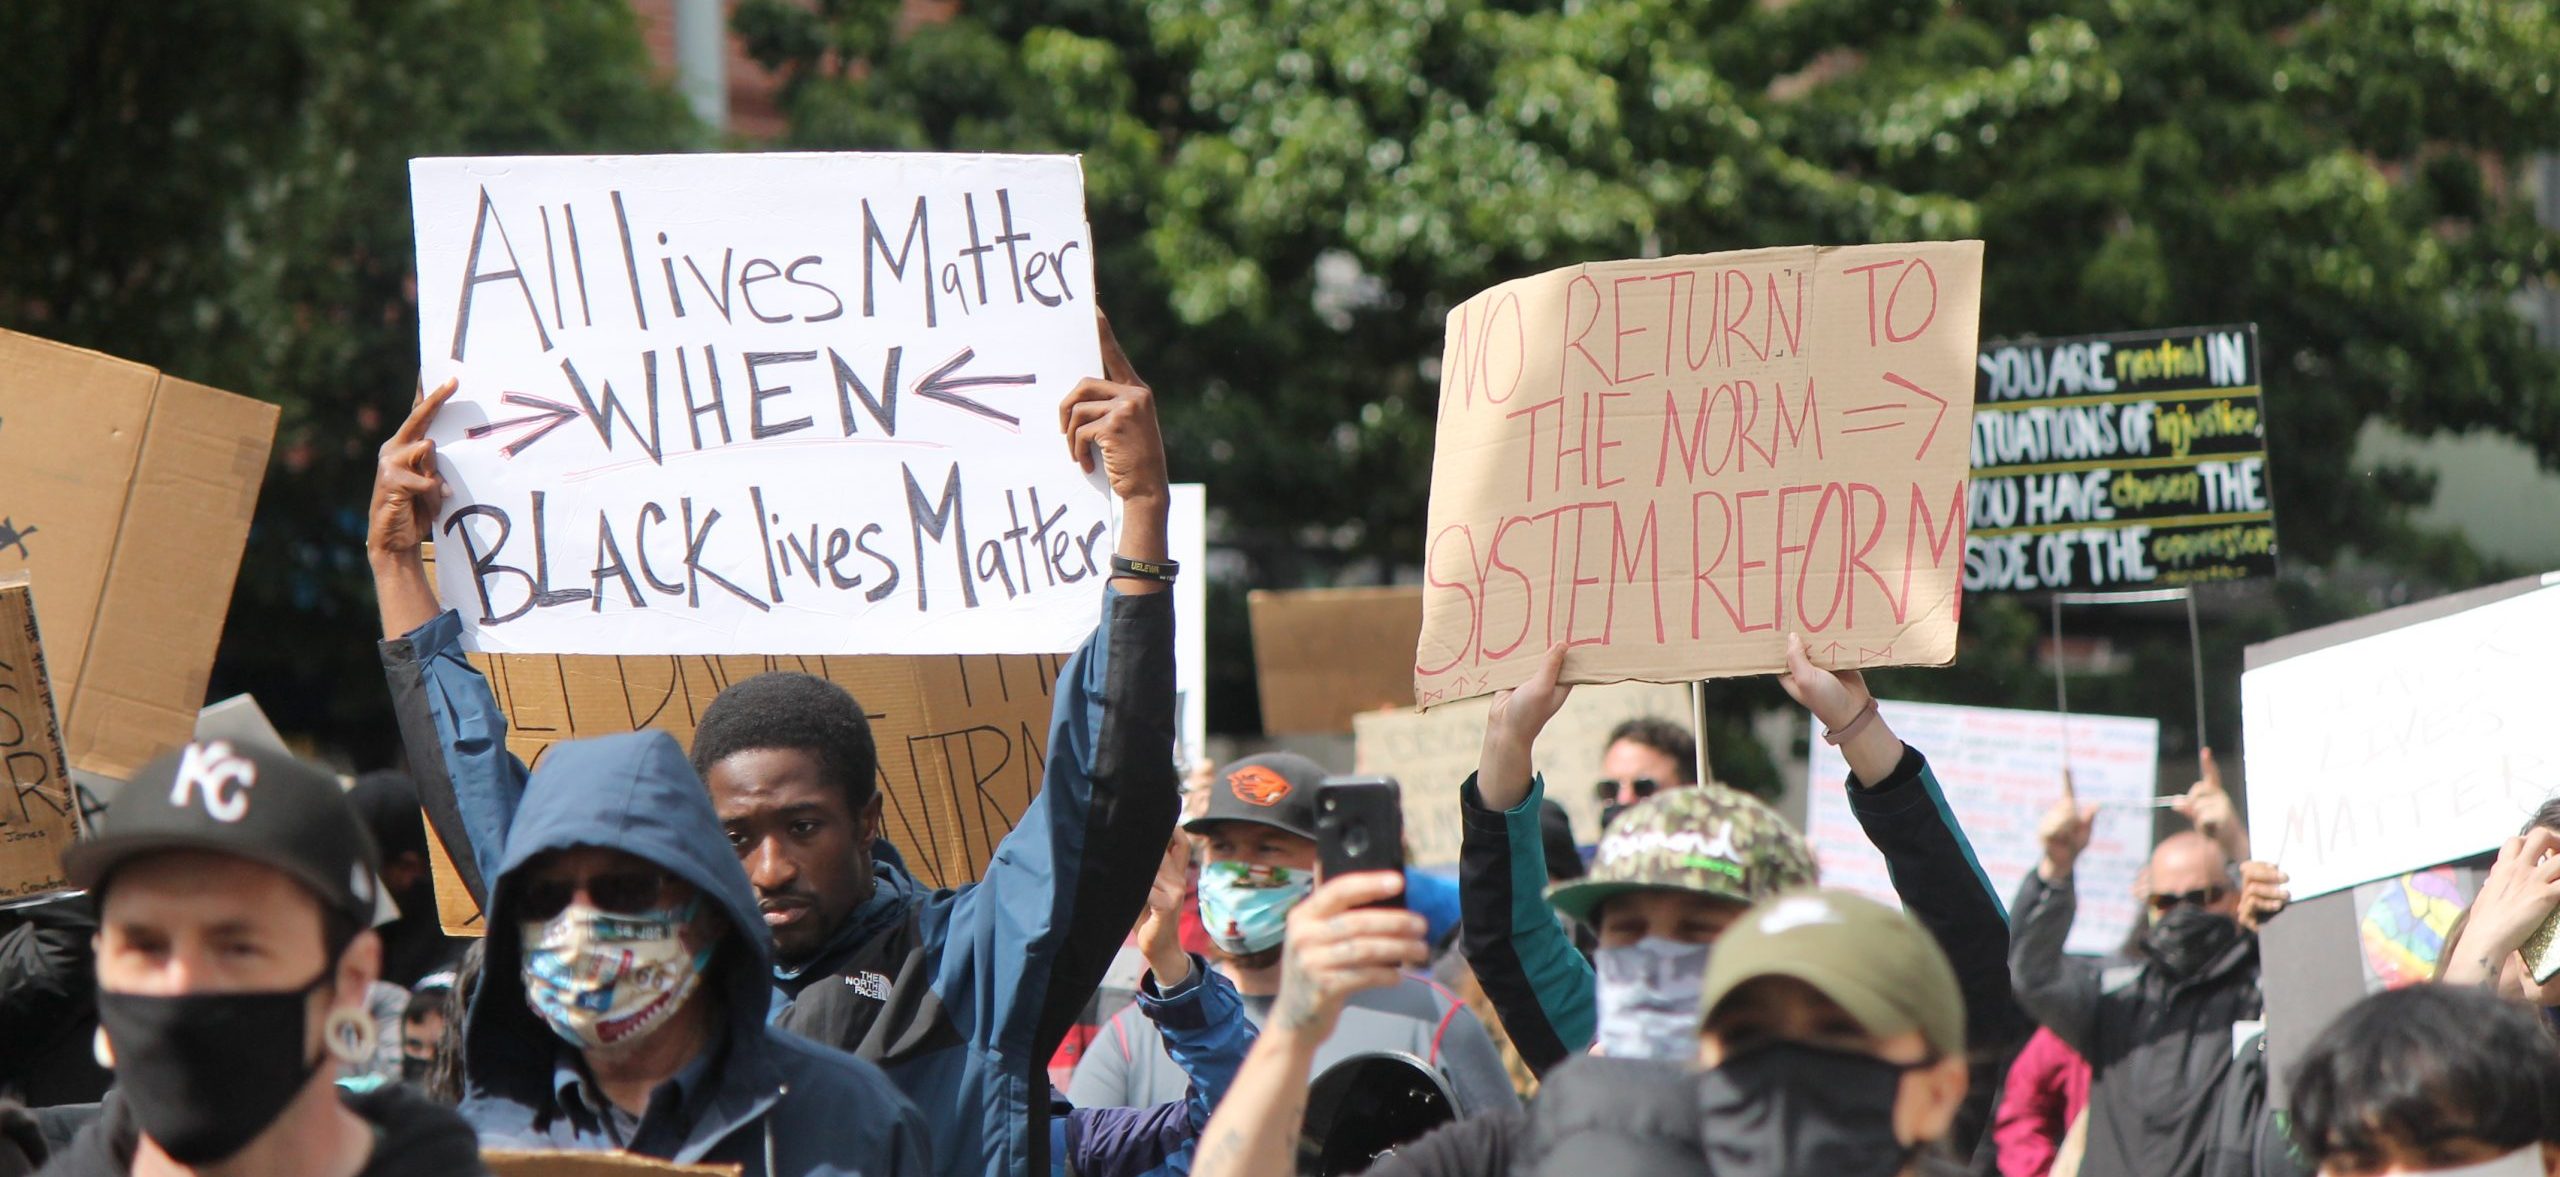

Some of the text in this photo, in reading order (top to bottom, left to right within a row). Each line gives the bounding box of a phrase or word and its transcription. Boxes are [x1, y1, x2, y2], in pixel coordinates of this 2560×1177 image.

[451, 184, 1079, 362] All lives Matter
[1438, 258, 1938, 424] NO RETURN TO
[1978, 346, 2046, 401] YOU
[2046, 341, 2117, 397] ARE
[2206, 332, 2247, 387] IN
[561, 346, 902, 465] WHEN
[1506, 375, 1824, 502] THE NORM
[2119, 399, 2156, 457] OF
[2024, 468, 2116, 526] HAVE
[2197, 457, 2268, 513] THE
[444, 460, 1107, 626] BLACK lives Matter
[1416, 479, 1966, 676] SYSTEM REFORM
[1962, 532, 2039, 592] SIDE
[2037, 528, 2080, 587] OF
[2080, 525, 2158, 586] THE
[170, 740, 258, 821] KC
[845, 976, 880, 991] NORTH
[854, 985, 880, 999] FACE
[860, 970, 880, 982] THE
